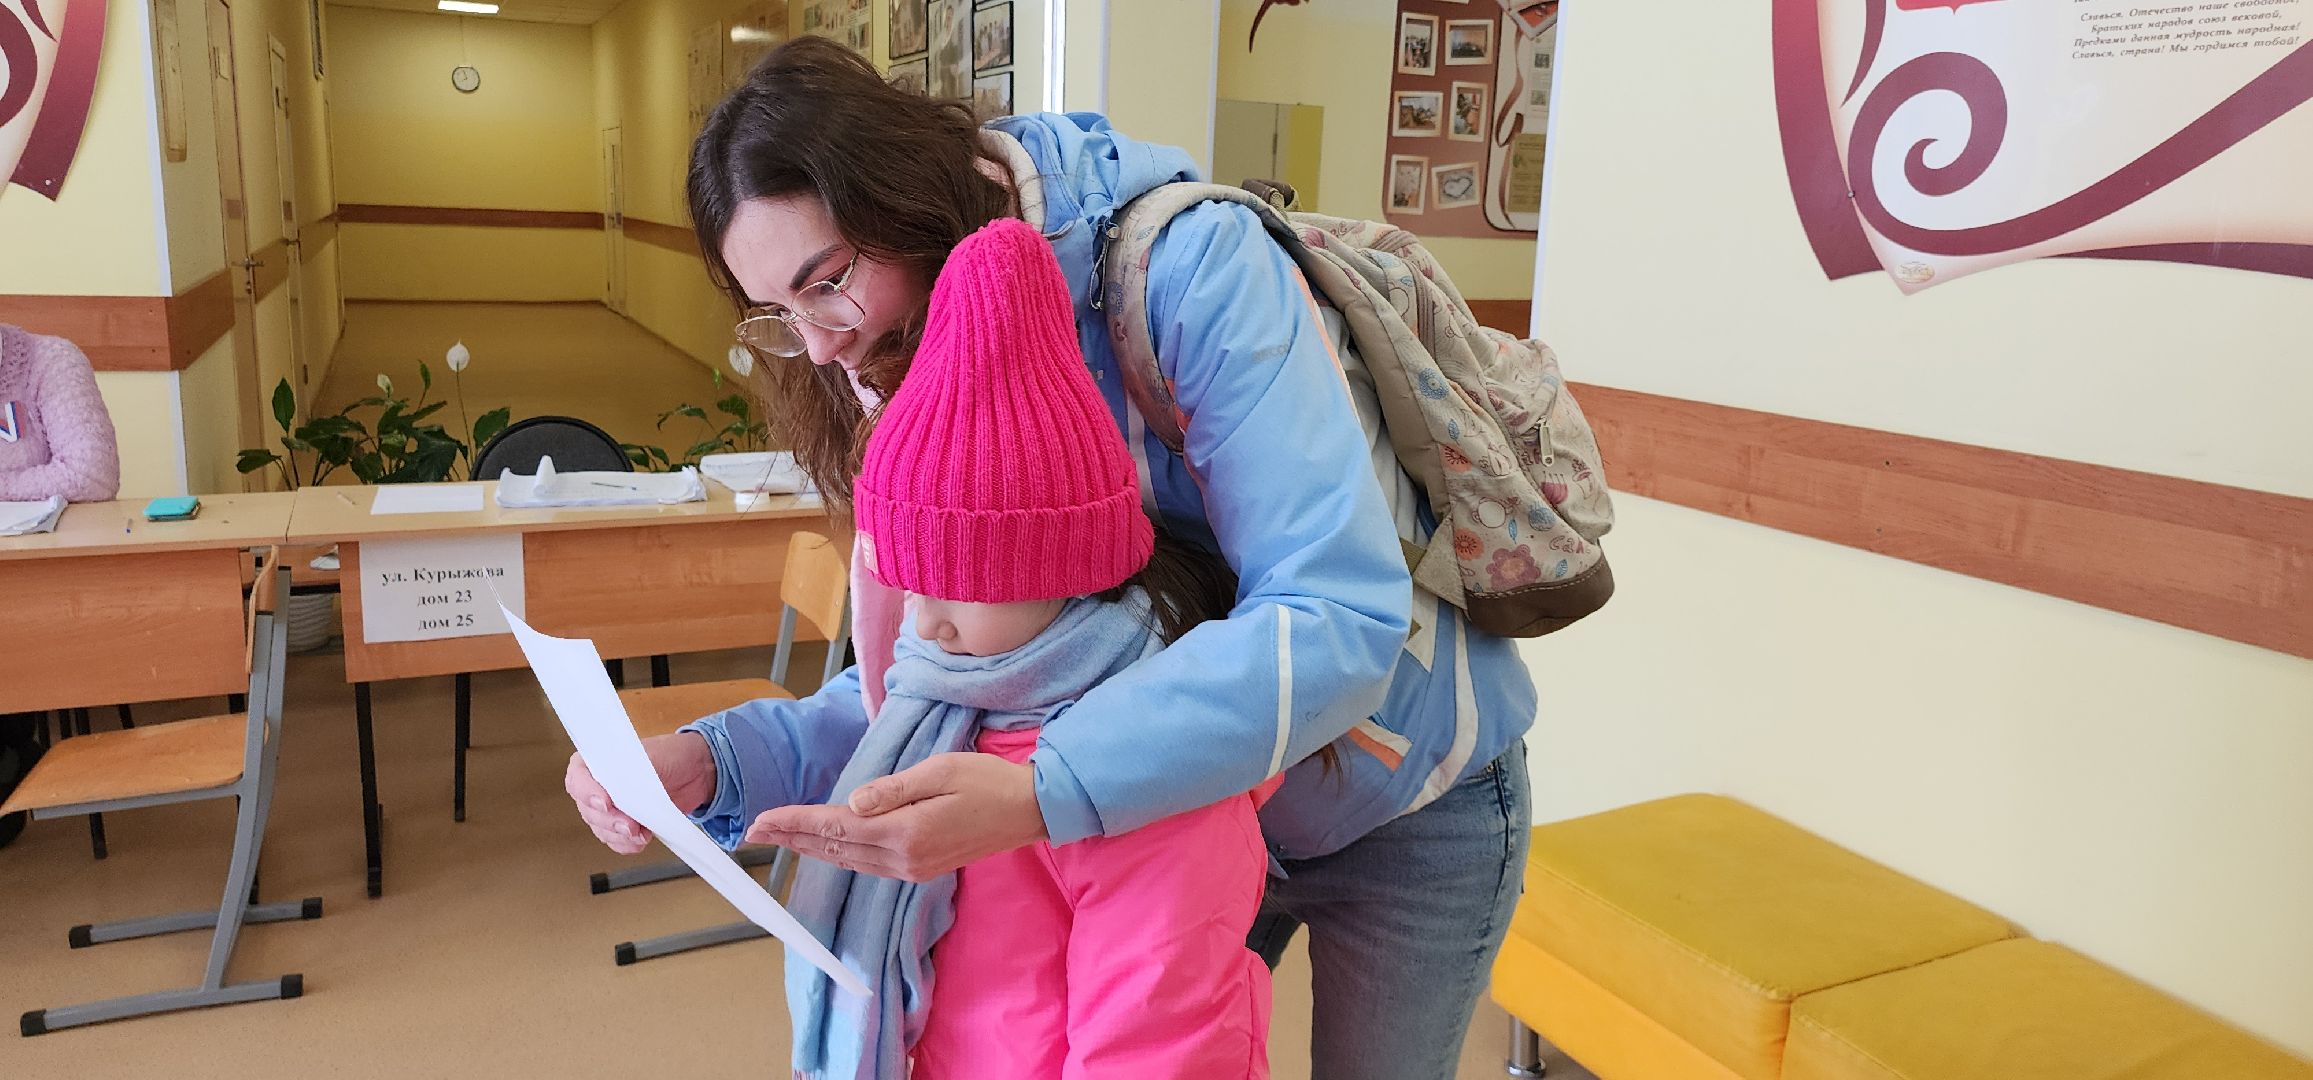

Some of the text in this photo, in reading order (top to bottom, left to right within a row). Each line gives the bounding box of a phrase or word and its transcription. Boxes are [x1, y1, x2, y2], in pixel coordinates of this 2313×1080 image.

[2129, 5, 2193, 16] Отечество
[2199, 3, 2229, 11] наше
[2091, 23, 2143, 34] Братских
[2148, 17, 2193, 30] народов
[2198, 16, 2227, 25] союз
[2074, 21, 2301, 48] Предками данная мудрость народная!
[2072, 36, 2299, 59] Славься, страна! Мы гордимся тобой!
[382, 572, 407, 586] ул.
[418, 590, 472, 606] дом 23
[418, 614, 474, 630] дом 25
